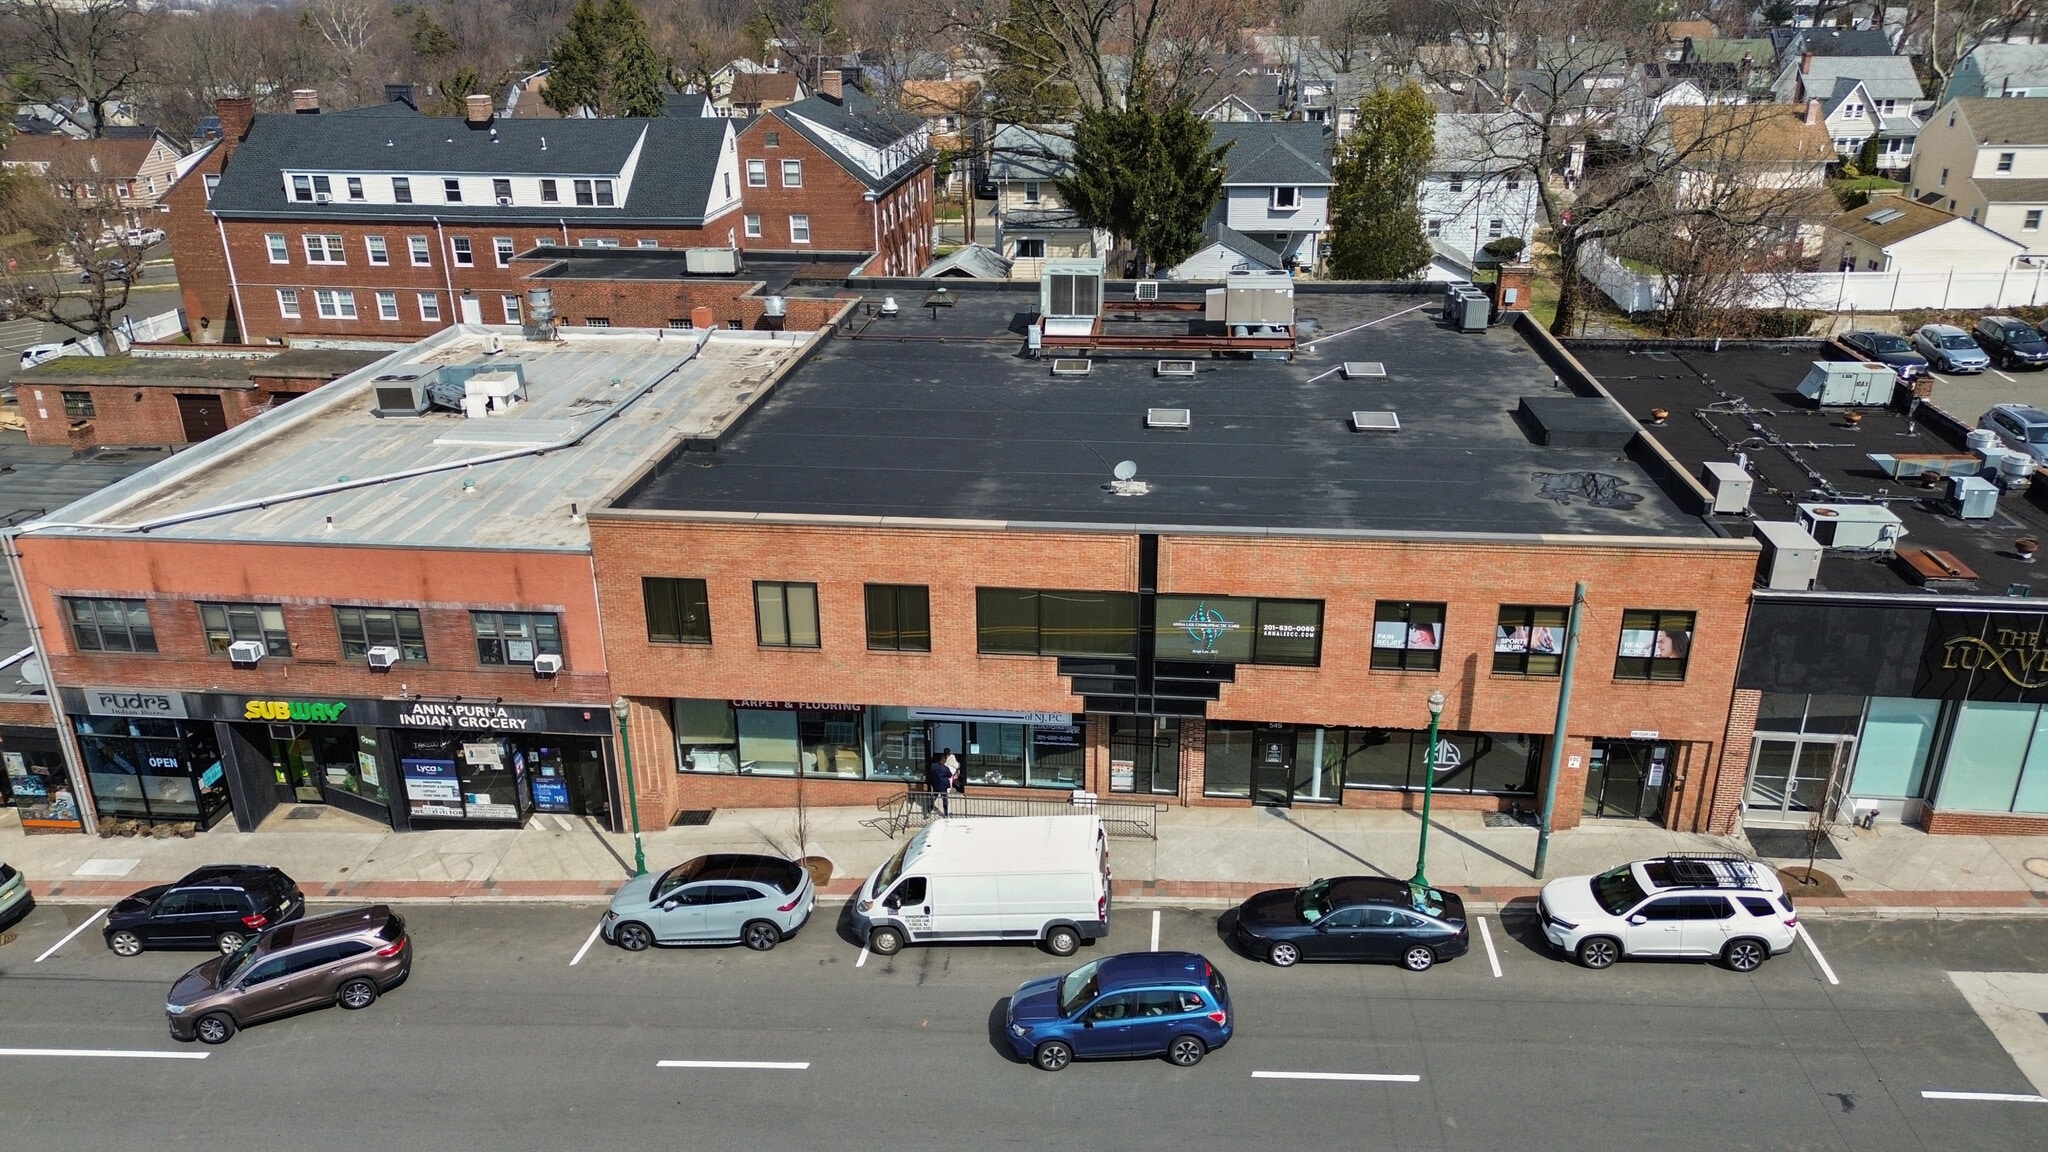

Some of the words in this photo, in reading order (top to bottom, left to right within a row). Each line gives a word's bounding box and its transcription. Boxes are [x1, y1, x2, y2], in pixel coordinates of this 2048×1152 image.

[1996, 628, 2040, 646] THE
[244, 700, 347, 721] SUBWAY
[413, 704, 508, 718] ANNAPURNA
[732, 699, 779, 708] CARPET
[784, 701, 793, 709] &
[799, 702, 861, 711] FLOORING
[399, 714, 453, 727] INDIAN
[458, 717, 527, 730] GROCERY
[1024, 713, 1033, 721] of
[1035, 713, 1047, 723] NJ,
[1048, 714, 1065, 722] P.C.
[360, 735, 376, 747] Open
[149, 757, 178, 769] OPEN
[416, 765, 437, 773] Lyca
